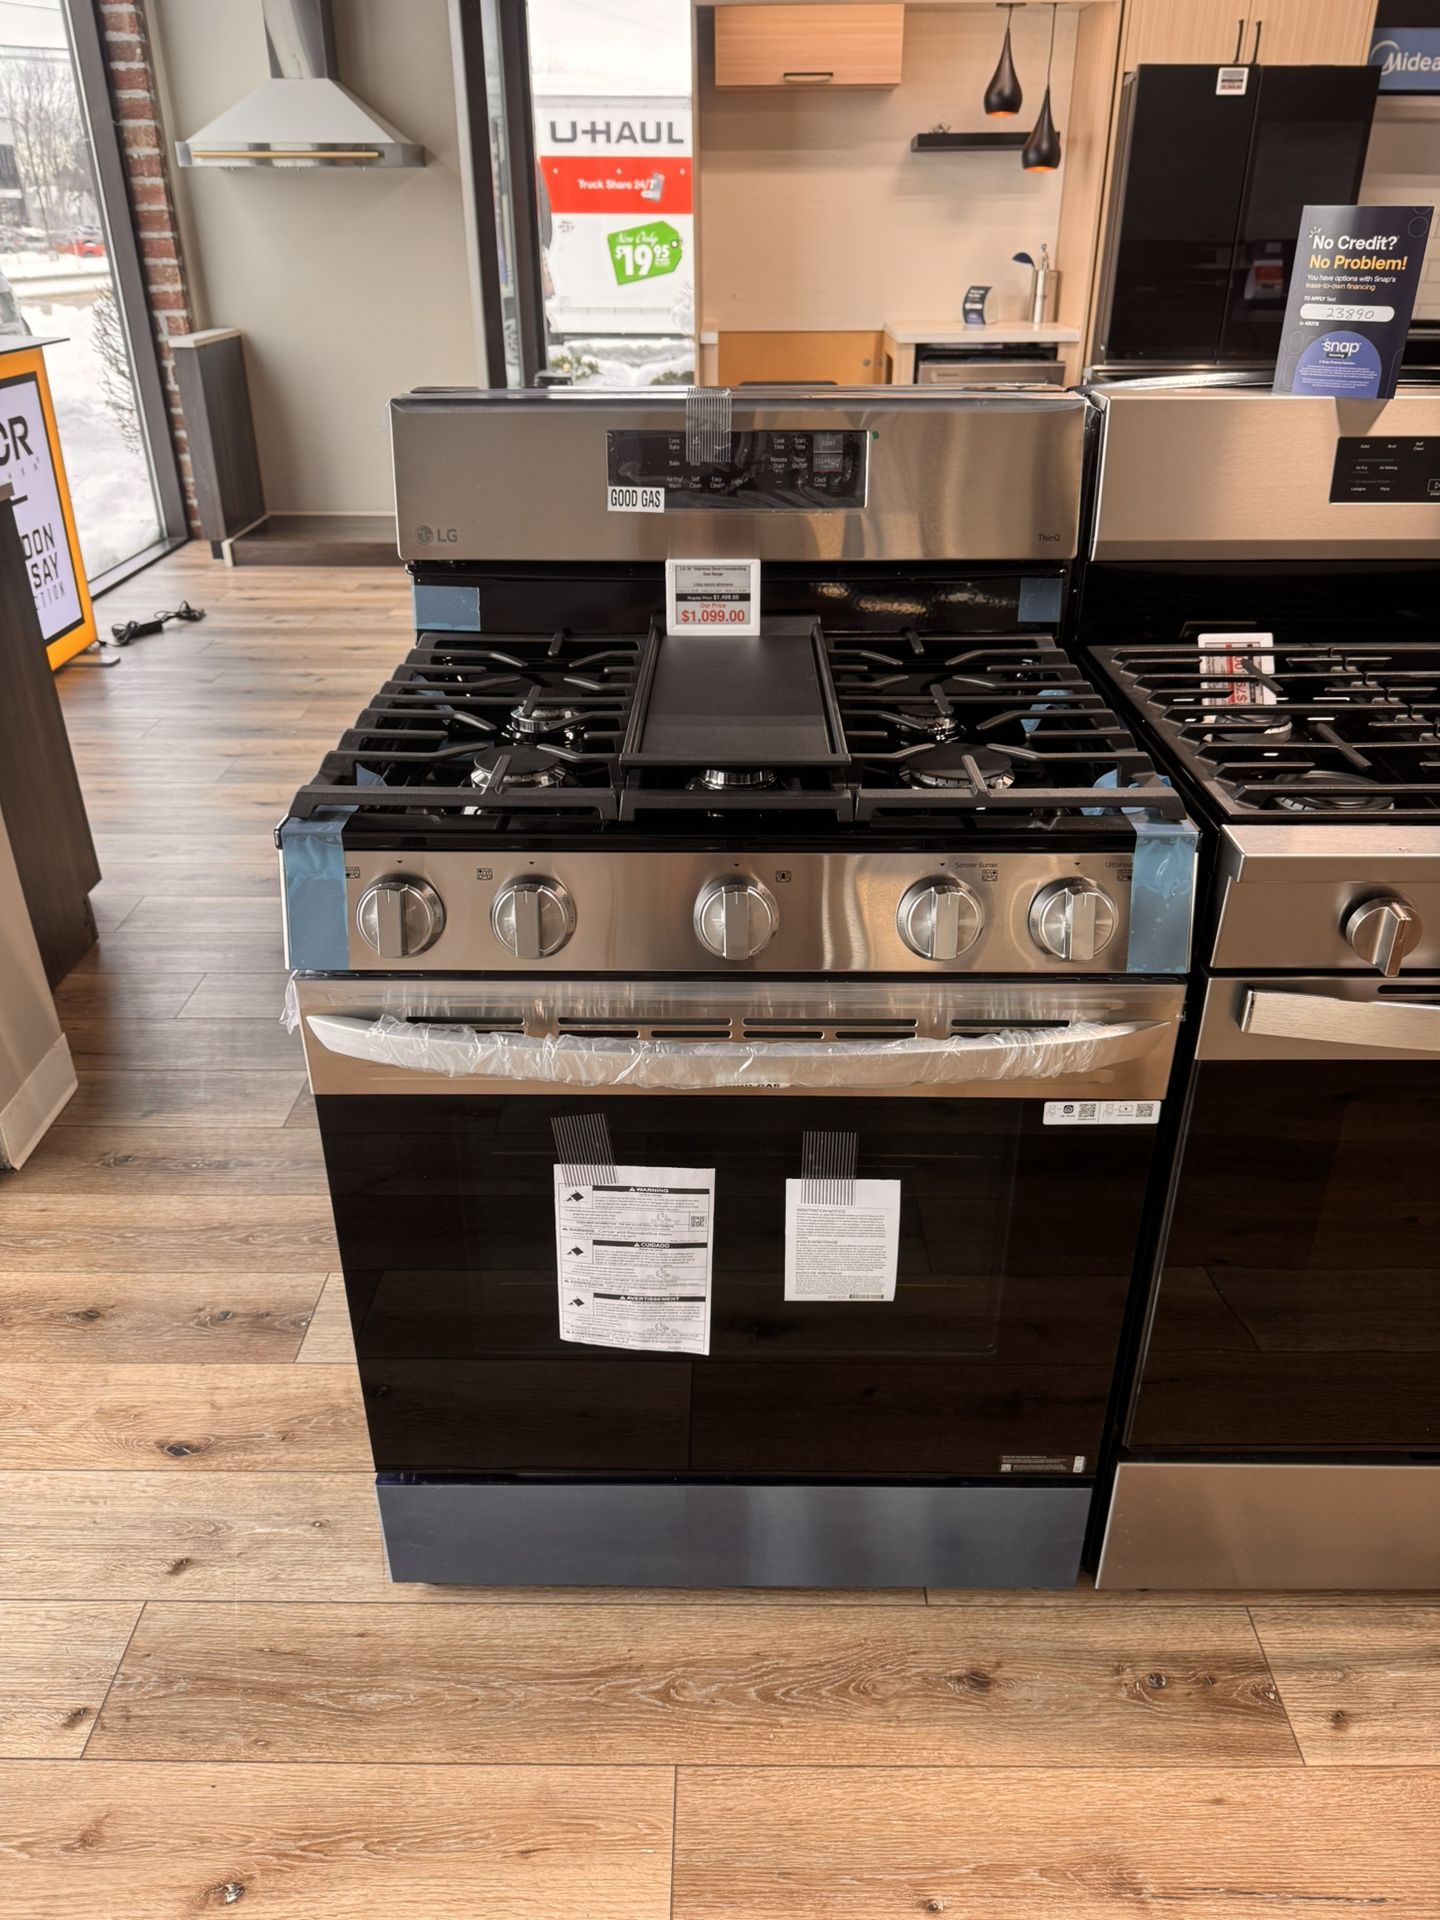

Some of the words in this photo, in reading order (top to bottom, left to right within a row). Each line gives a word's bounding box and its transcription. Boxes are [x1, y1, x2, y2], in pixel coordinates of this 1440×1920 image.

[1382, 52, 1440, 75] Midea
[577, 179, 603, 190] Truck
[606, 180, 632, 190] Share
[1312, 235, 1333, 250] No
[1338, 235, 1398, 250] Credit?
[1309, 255, 1329, 269] No
[1334, 255, 1408, 271] Problem!
[1305, 282, 1346, 290] lease-to-own
[1346, 283, 1376, 292] financing
[1334, 275, 1358, 283] options
[1374, 275, 1396, 284] Snap's
[1326, 307, 1375, 320] 23890
[1322, 340, 1360, 356] snap
[611, 489, 638, 507] GOOD
[641, 490, 661, 508] GAS
[437, 528, 458, 543] LG
[1037, 533, 1060, 542] ThinQ
[30, 552, 60, 589] SAY
[681, 610, 745, 623] $1,099.00
